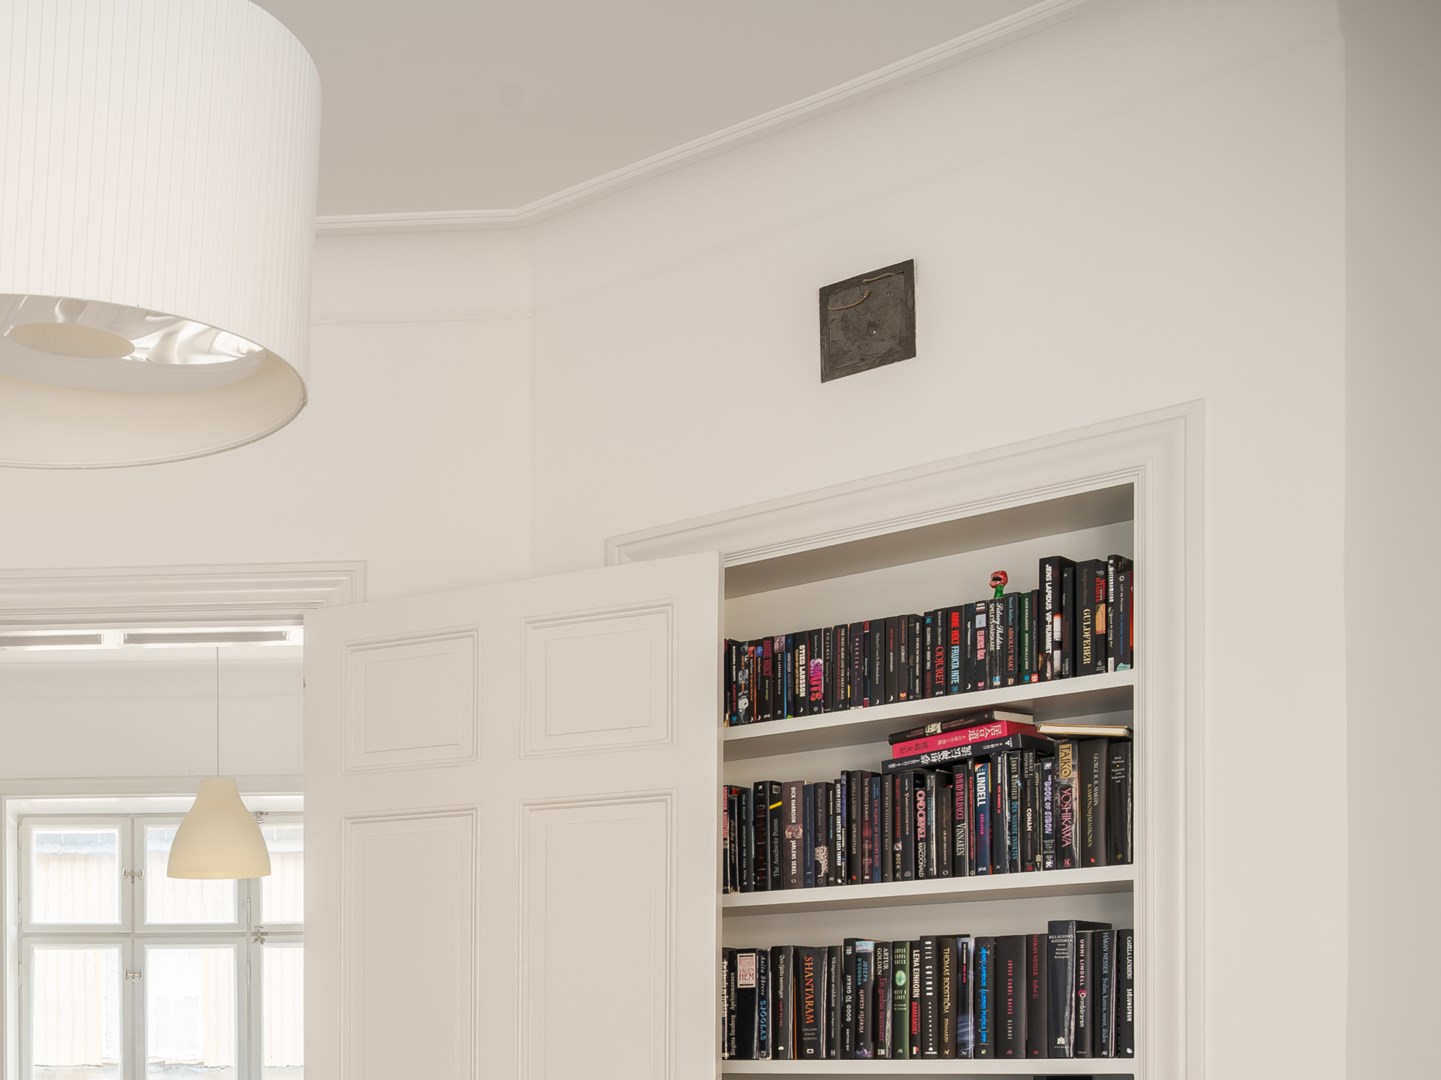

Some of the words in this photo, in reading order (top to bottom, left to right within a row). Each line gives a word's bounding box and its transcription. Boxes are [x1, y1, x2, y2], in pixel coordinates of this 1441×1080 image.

[1083, 609, 1091, 664] GULDFEBER
[810, 658, 823, 701] SMUTS
[934, 646, 944, 685] ODJURET
[951, 670, 959, 684] INTE
[1060, 745, 1071, 778] TAIKO
[976, 772, 986, 807] LINDELL
[1061, 788, 1072, 847] YOSHIKAWA
[804, 956, 814, 1024] SHANTARAM
